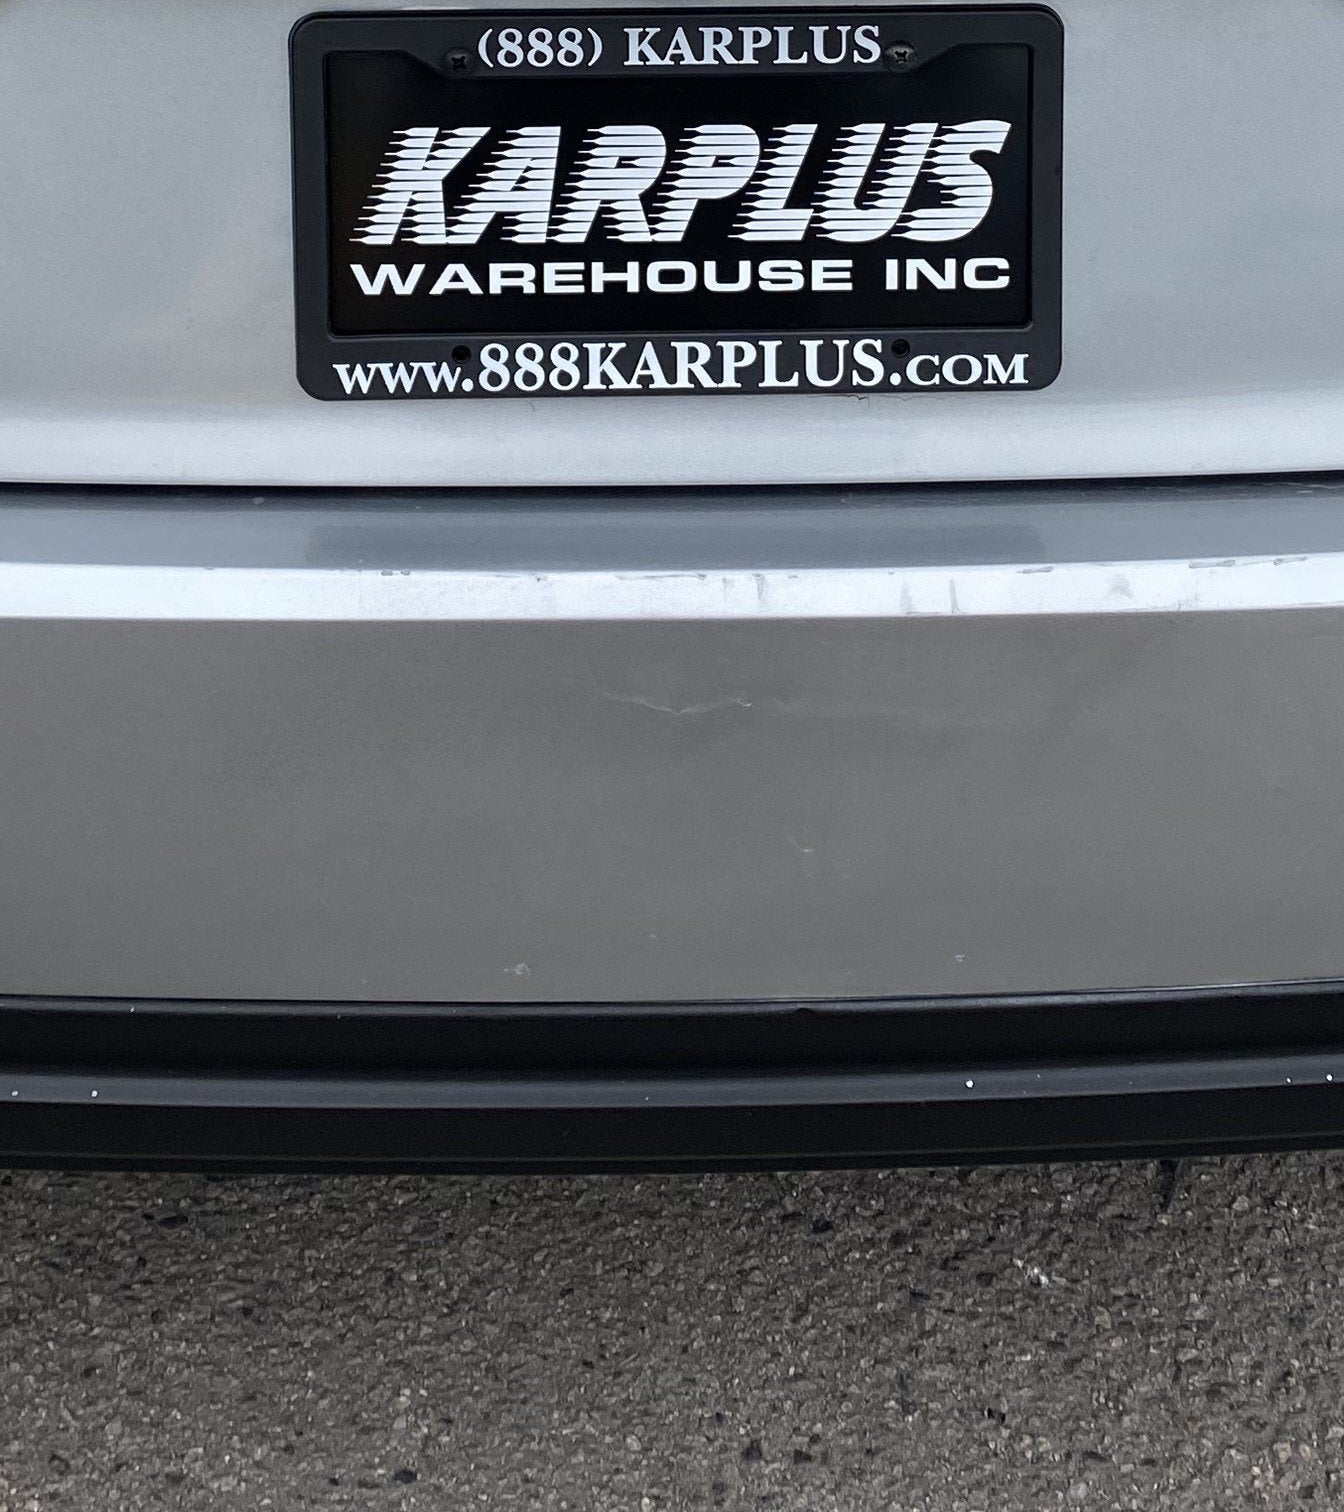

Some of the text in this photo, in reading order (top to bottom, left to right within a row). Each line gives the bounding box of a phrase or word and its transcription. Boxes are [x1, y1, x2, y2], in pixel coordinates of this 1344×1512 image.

[478, 25, 881, 68] (888) KARPLUS
[349, 119, 1012, 246] KARPLUS
[349, 257, 1010, 296] WAREHOUSE INC
